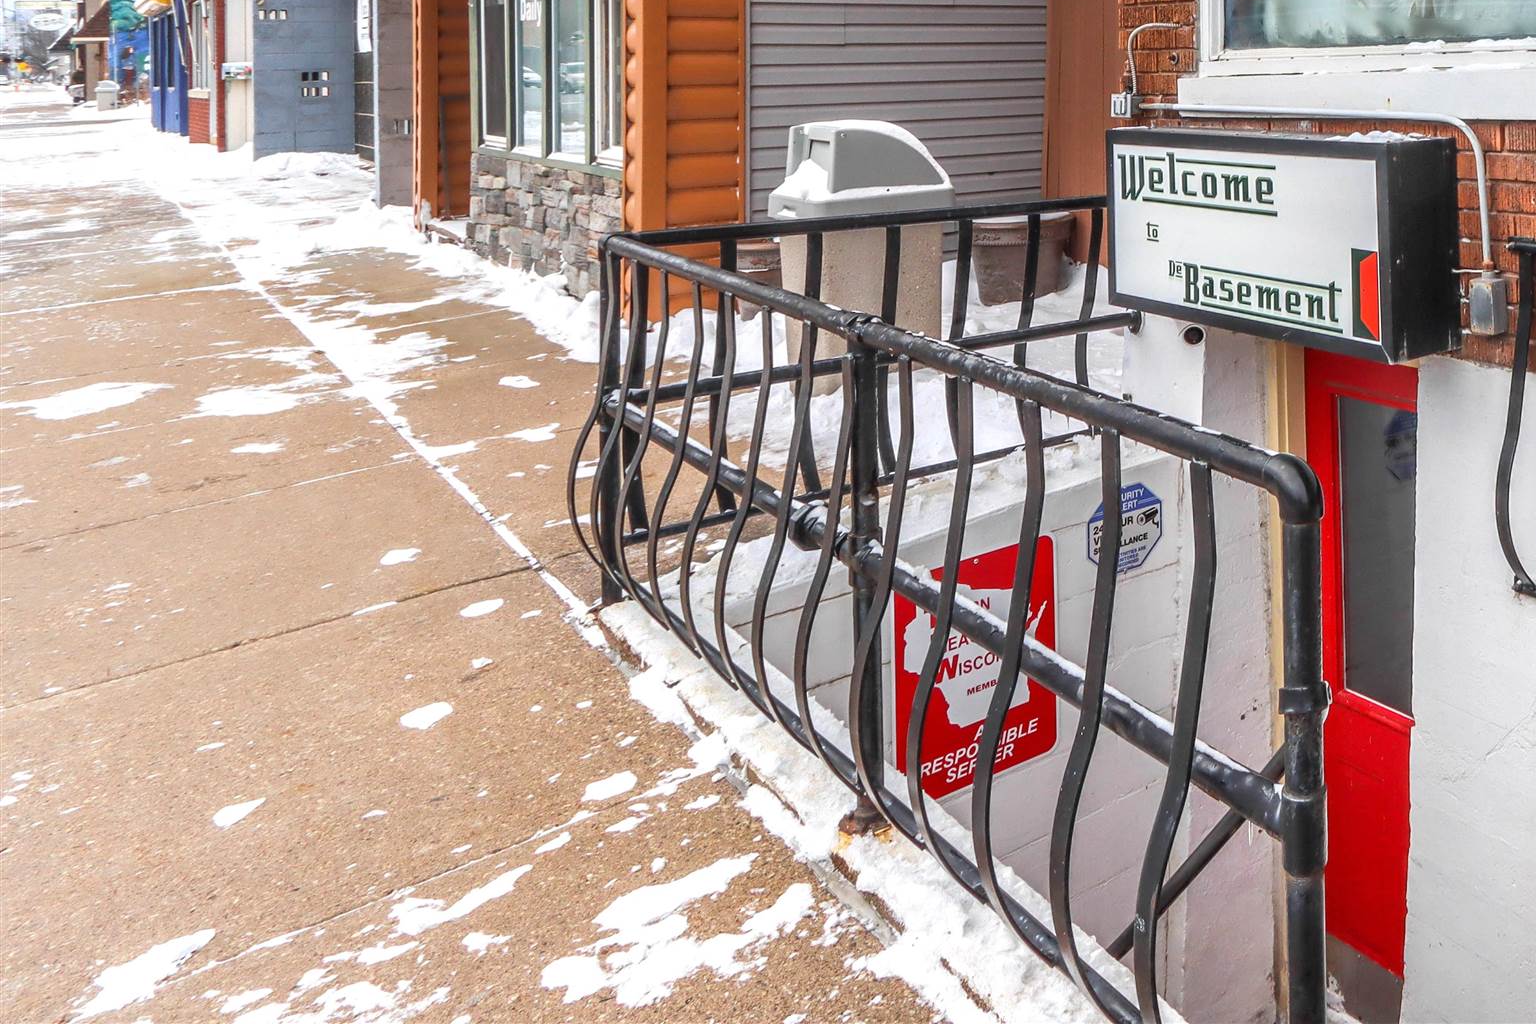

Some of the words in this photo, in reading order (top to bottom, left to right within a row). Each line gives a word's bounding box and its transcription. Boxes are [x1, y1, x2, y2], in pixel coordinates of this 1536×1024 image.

[1117, 152, 1275, 205] Welcome
[1146, 222, 1159, 239] to
[1168, 259, 1183, 277] De
[1183, 263, 1342, 324] Basement
[1121, 488, 1144, 501] URITY
[1122, 499, 1138, 511] ERT
[920, 718, 1039, 778] RESPOIBLE
